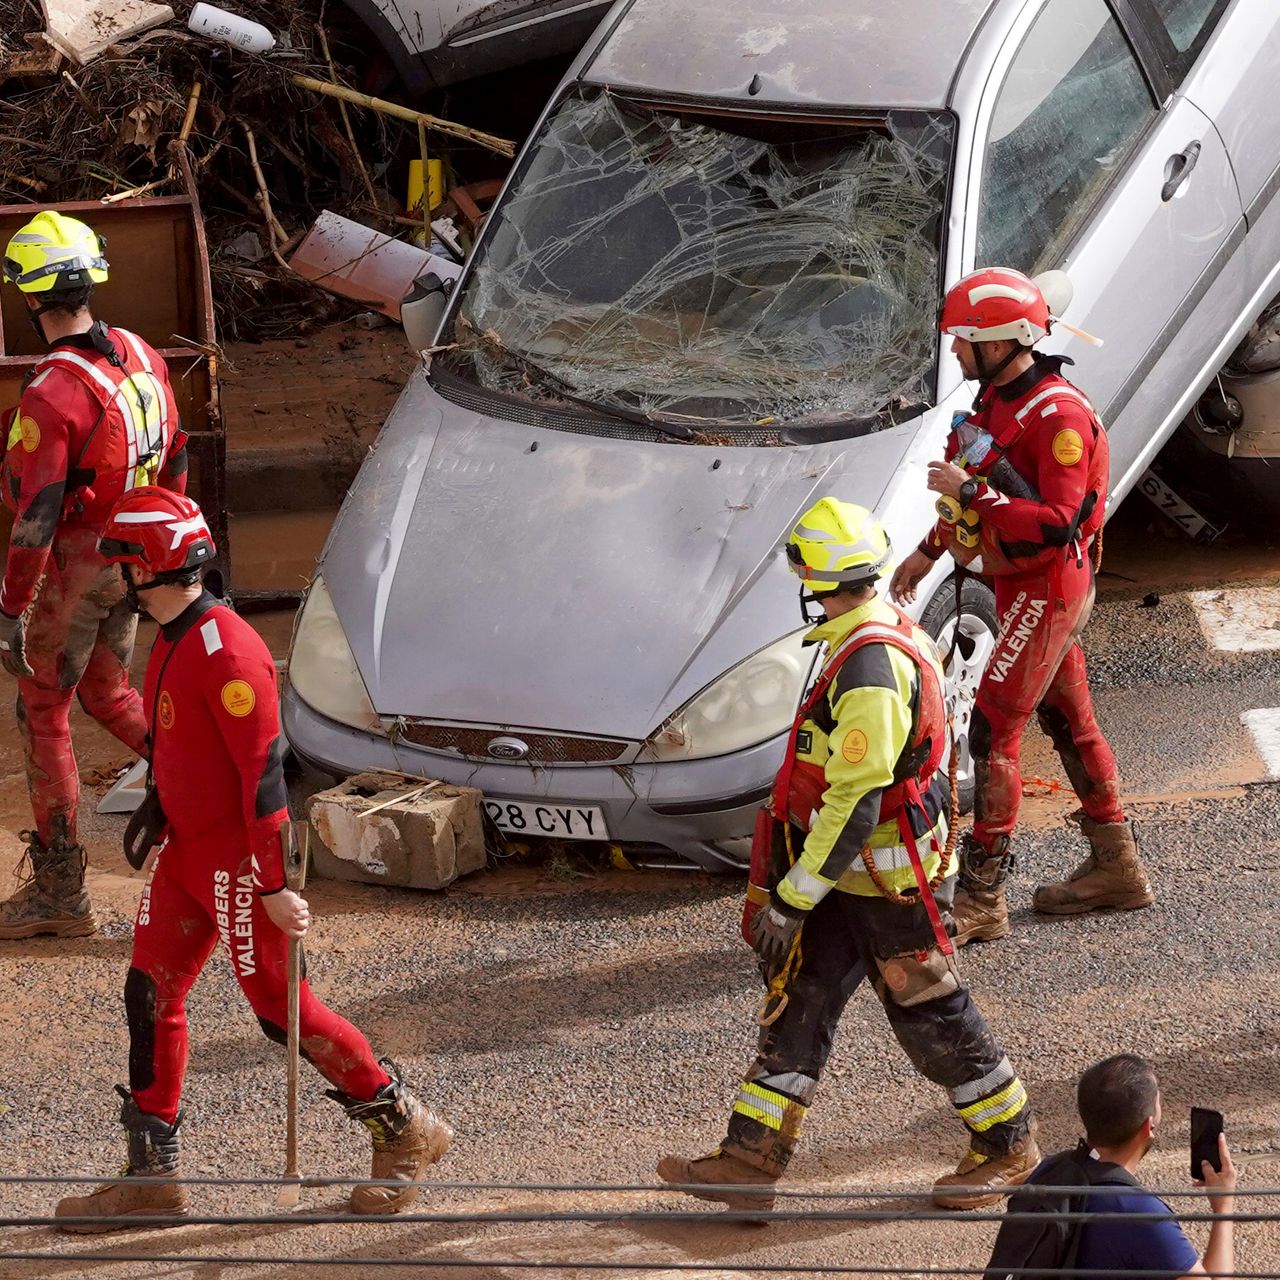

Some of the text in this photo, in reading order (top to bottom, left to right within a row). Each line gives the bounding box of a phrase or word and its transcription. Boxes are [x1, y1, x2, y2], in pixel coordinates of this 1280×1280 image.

[1142, 477, 1198, 530] 749
[988, 598, 1049, 683] VALÈNCIA
[494, 745, 515, 757] Ford
[535, 806, 594, 836] CYY
[214, 869, 233, 960] OMBERS
[232, 873, 257, 977] VALÈNCIA
